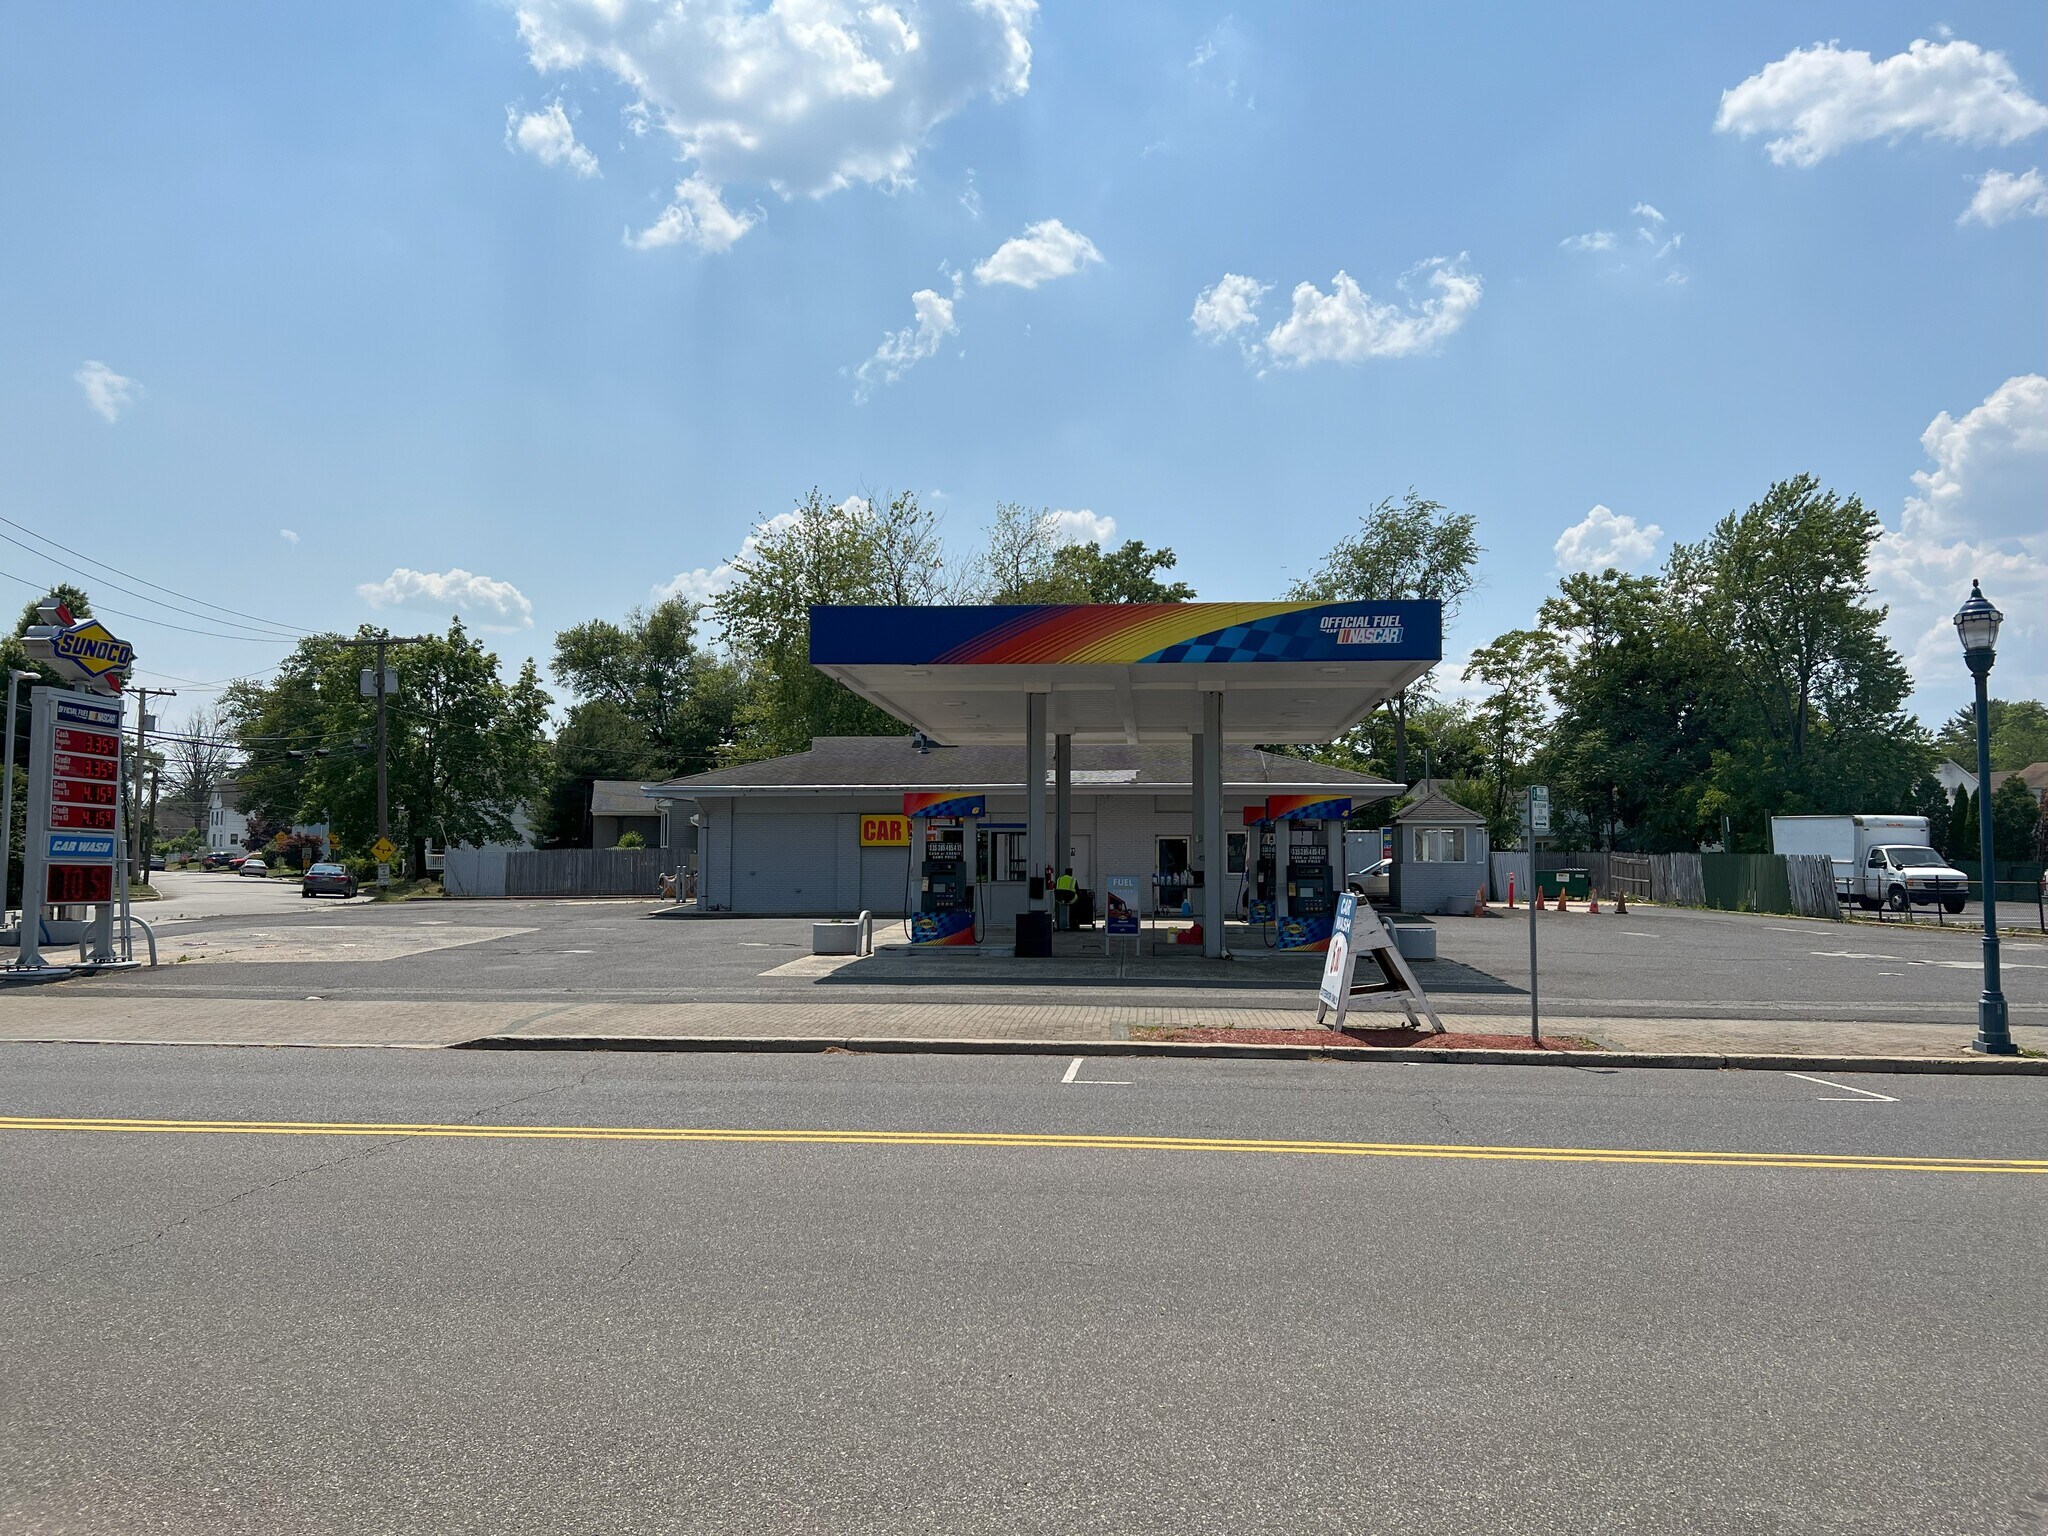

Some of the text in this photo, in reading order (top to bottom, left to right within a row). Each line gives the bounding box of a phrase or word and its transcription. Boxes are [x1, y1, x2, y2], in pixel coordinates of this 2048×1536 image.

[1320, 615, 1402, 628] OFFICIAL FUEL
[1347, 628, 1400, 643] NASCAR
[60, 634, 131, 664] SUNOCO
[58, 705, 89, 717] OFFICIAL FUEL
[56, 729, 69, 738] Cash
[55, 755, 71, 764] Credit
[53, 780, 67, 789] Cash
[52, 805, 69, 814] Credit
[971, 806, 980, 814] 6
[1341, 809, 1349, 817] 4
[863, 819, 902, 841] CAR
[52, 840, 111, 853] CAR WASH
[1341, 898, 1352, 916] CAR
[1336, 917, 1352, 934] WASH
